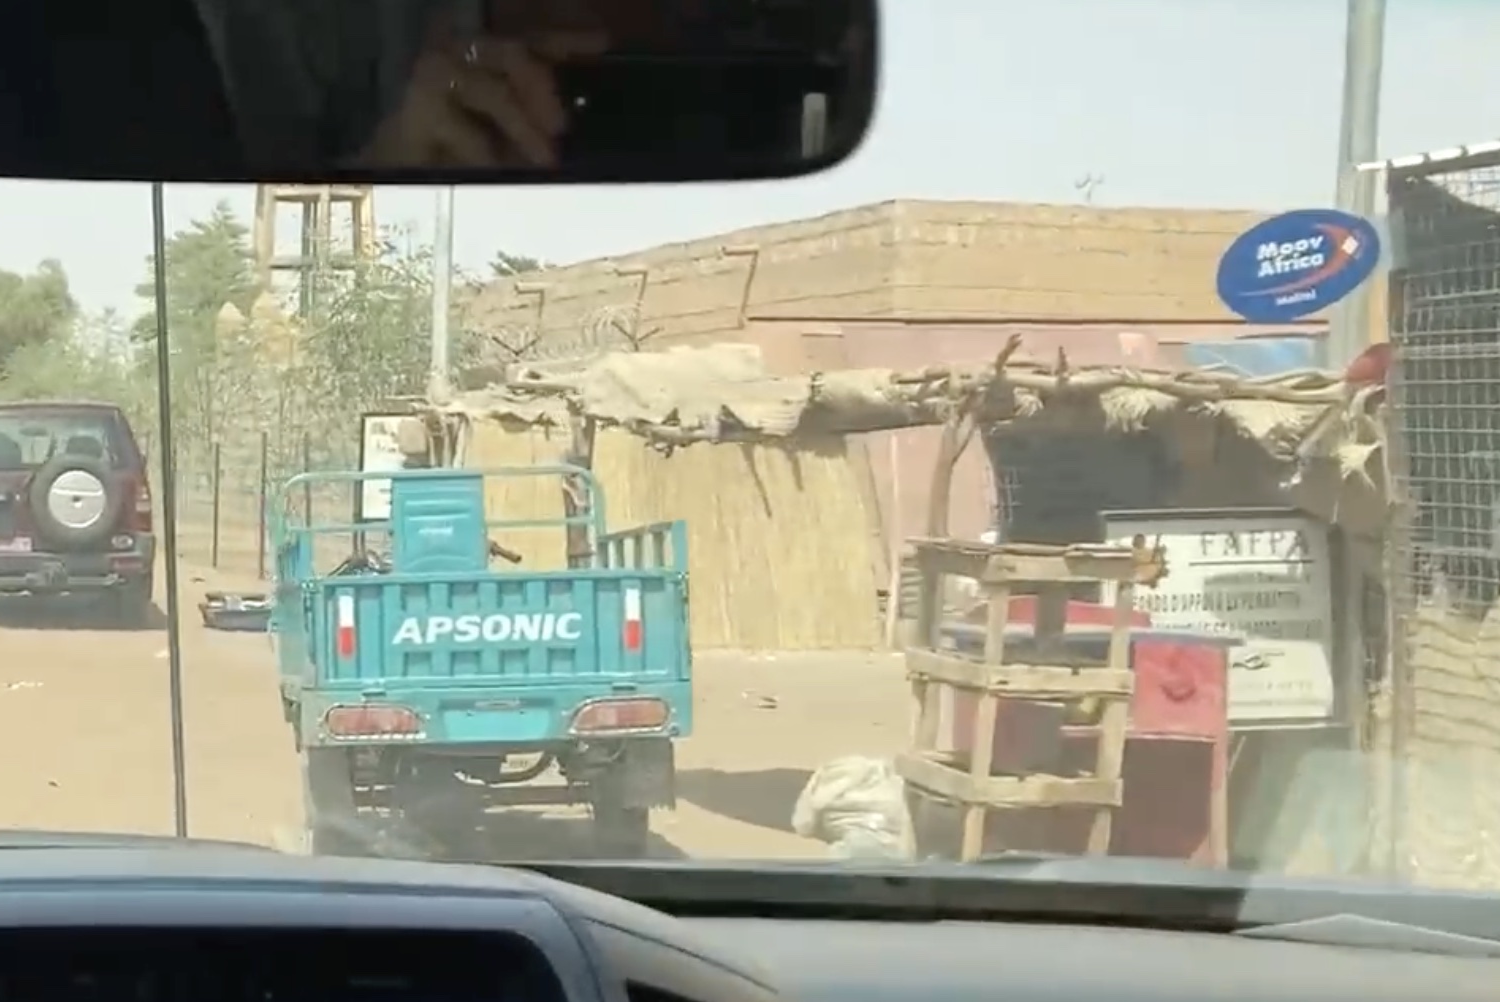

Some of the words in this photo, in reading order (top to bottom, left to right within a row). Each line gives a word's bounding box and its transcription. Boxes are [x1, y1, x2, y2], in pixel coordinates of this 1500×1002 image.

[1256, 236, 1324, 261] Moov
[1257, 253, 1324, 278] Africa
[392, 612, 582, 645] APSONIC
